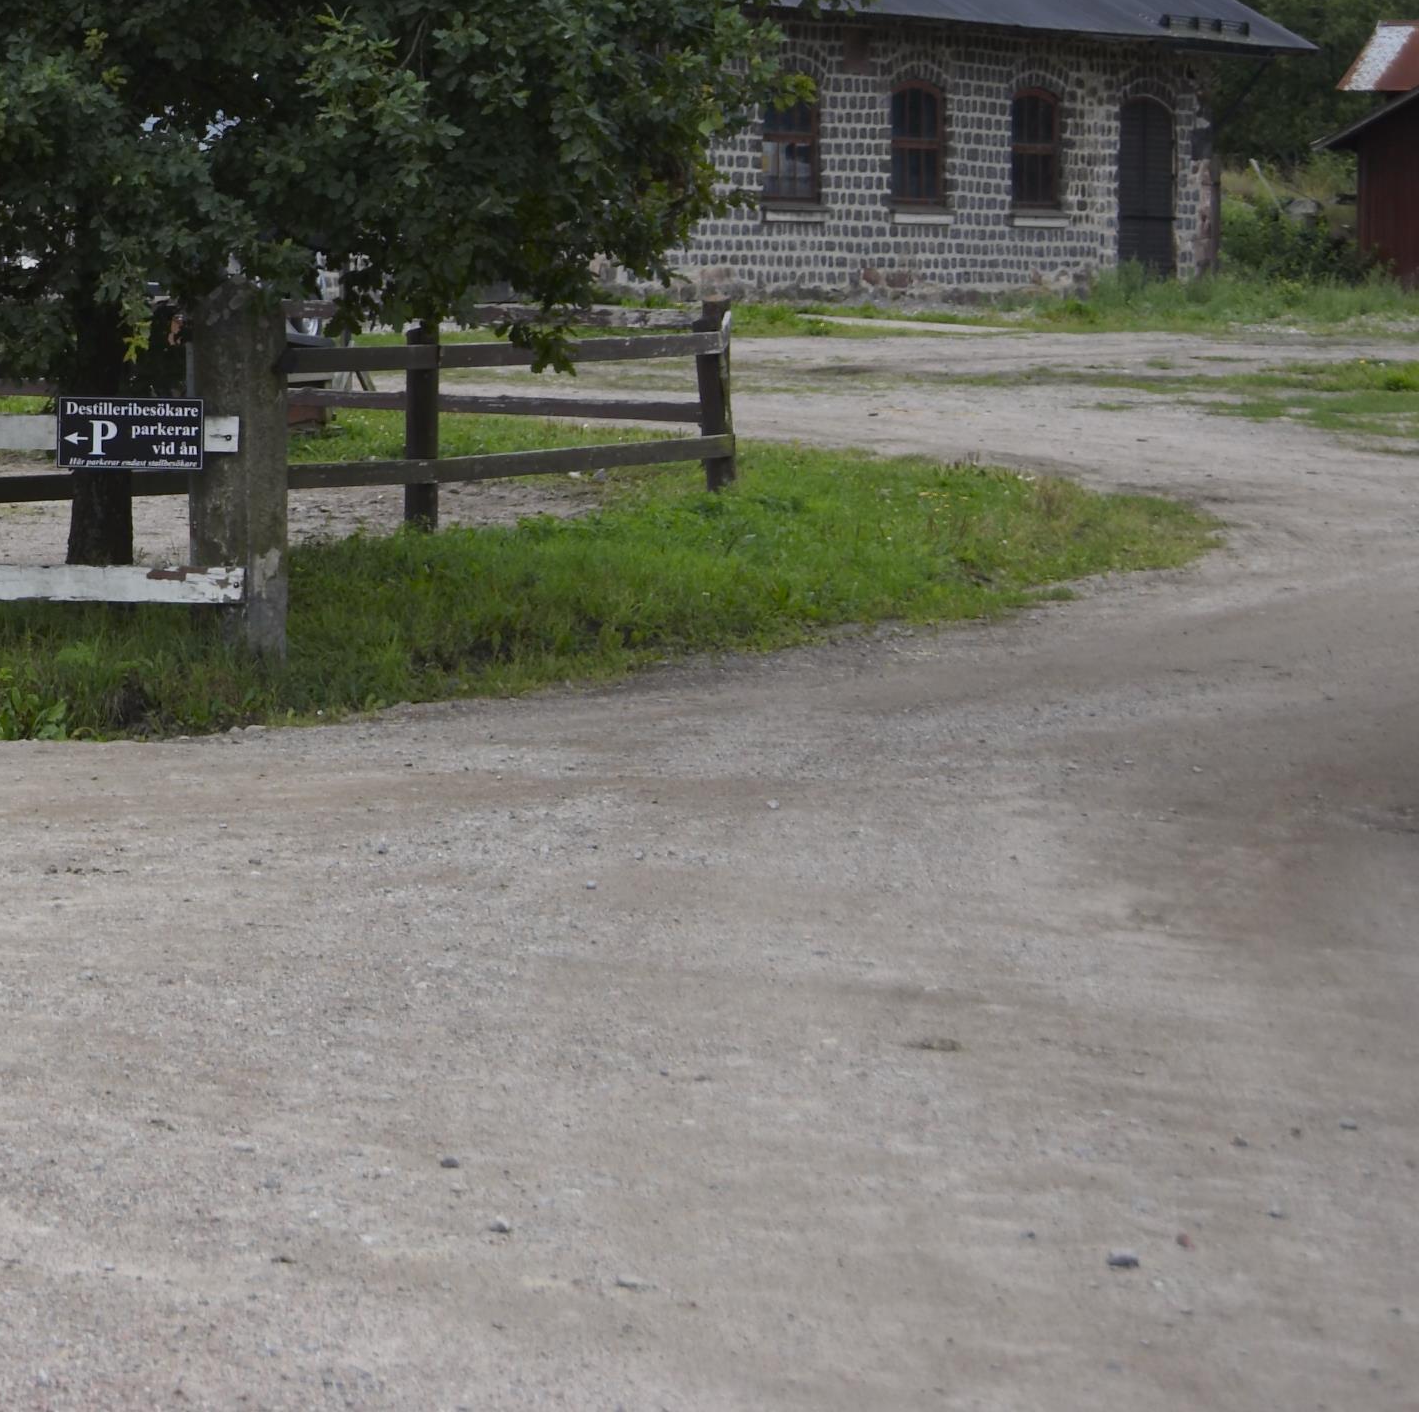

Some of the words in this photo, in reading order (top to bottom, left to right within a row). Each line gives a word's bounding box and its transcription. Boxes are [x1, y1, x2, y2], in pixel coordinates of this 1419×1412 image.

[66, 401, 199, 417] Destilleribesökare
[88, 420, 118, 455] P
[131, 422, 199, 439] parkerar
[152, 442, 175, 455] vid
[179, 441, 198, 456] ån
[69, 457, 85, 465] Här
[86, 458, 120, 468] parkerar
